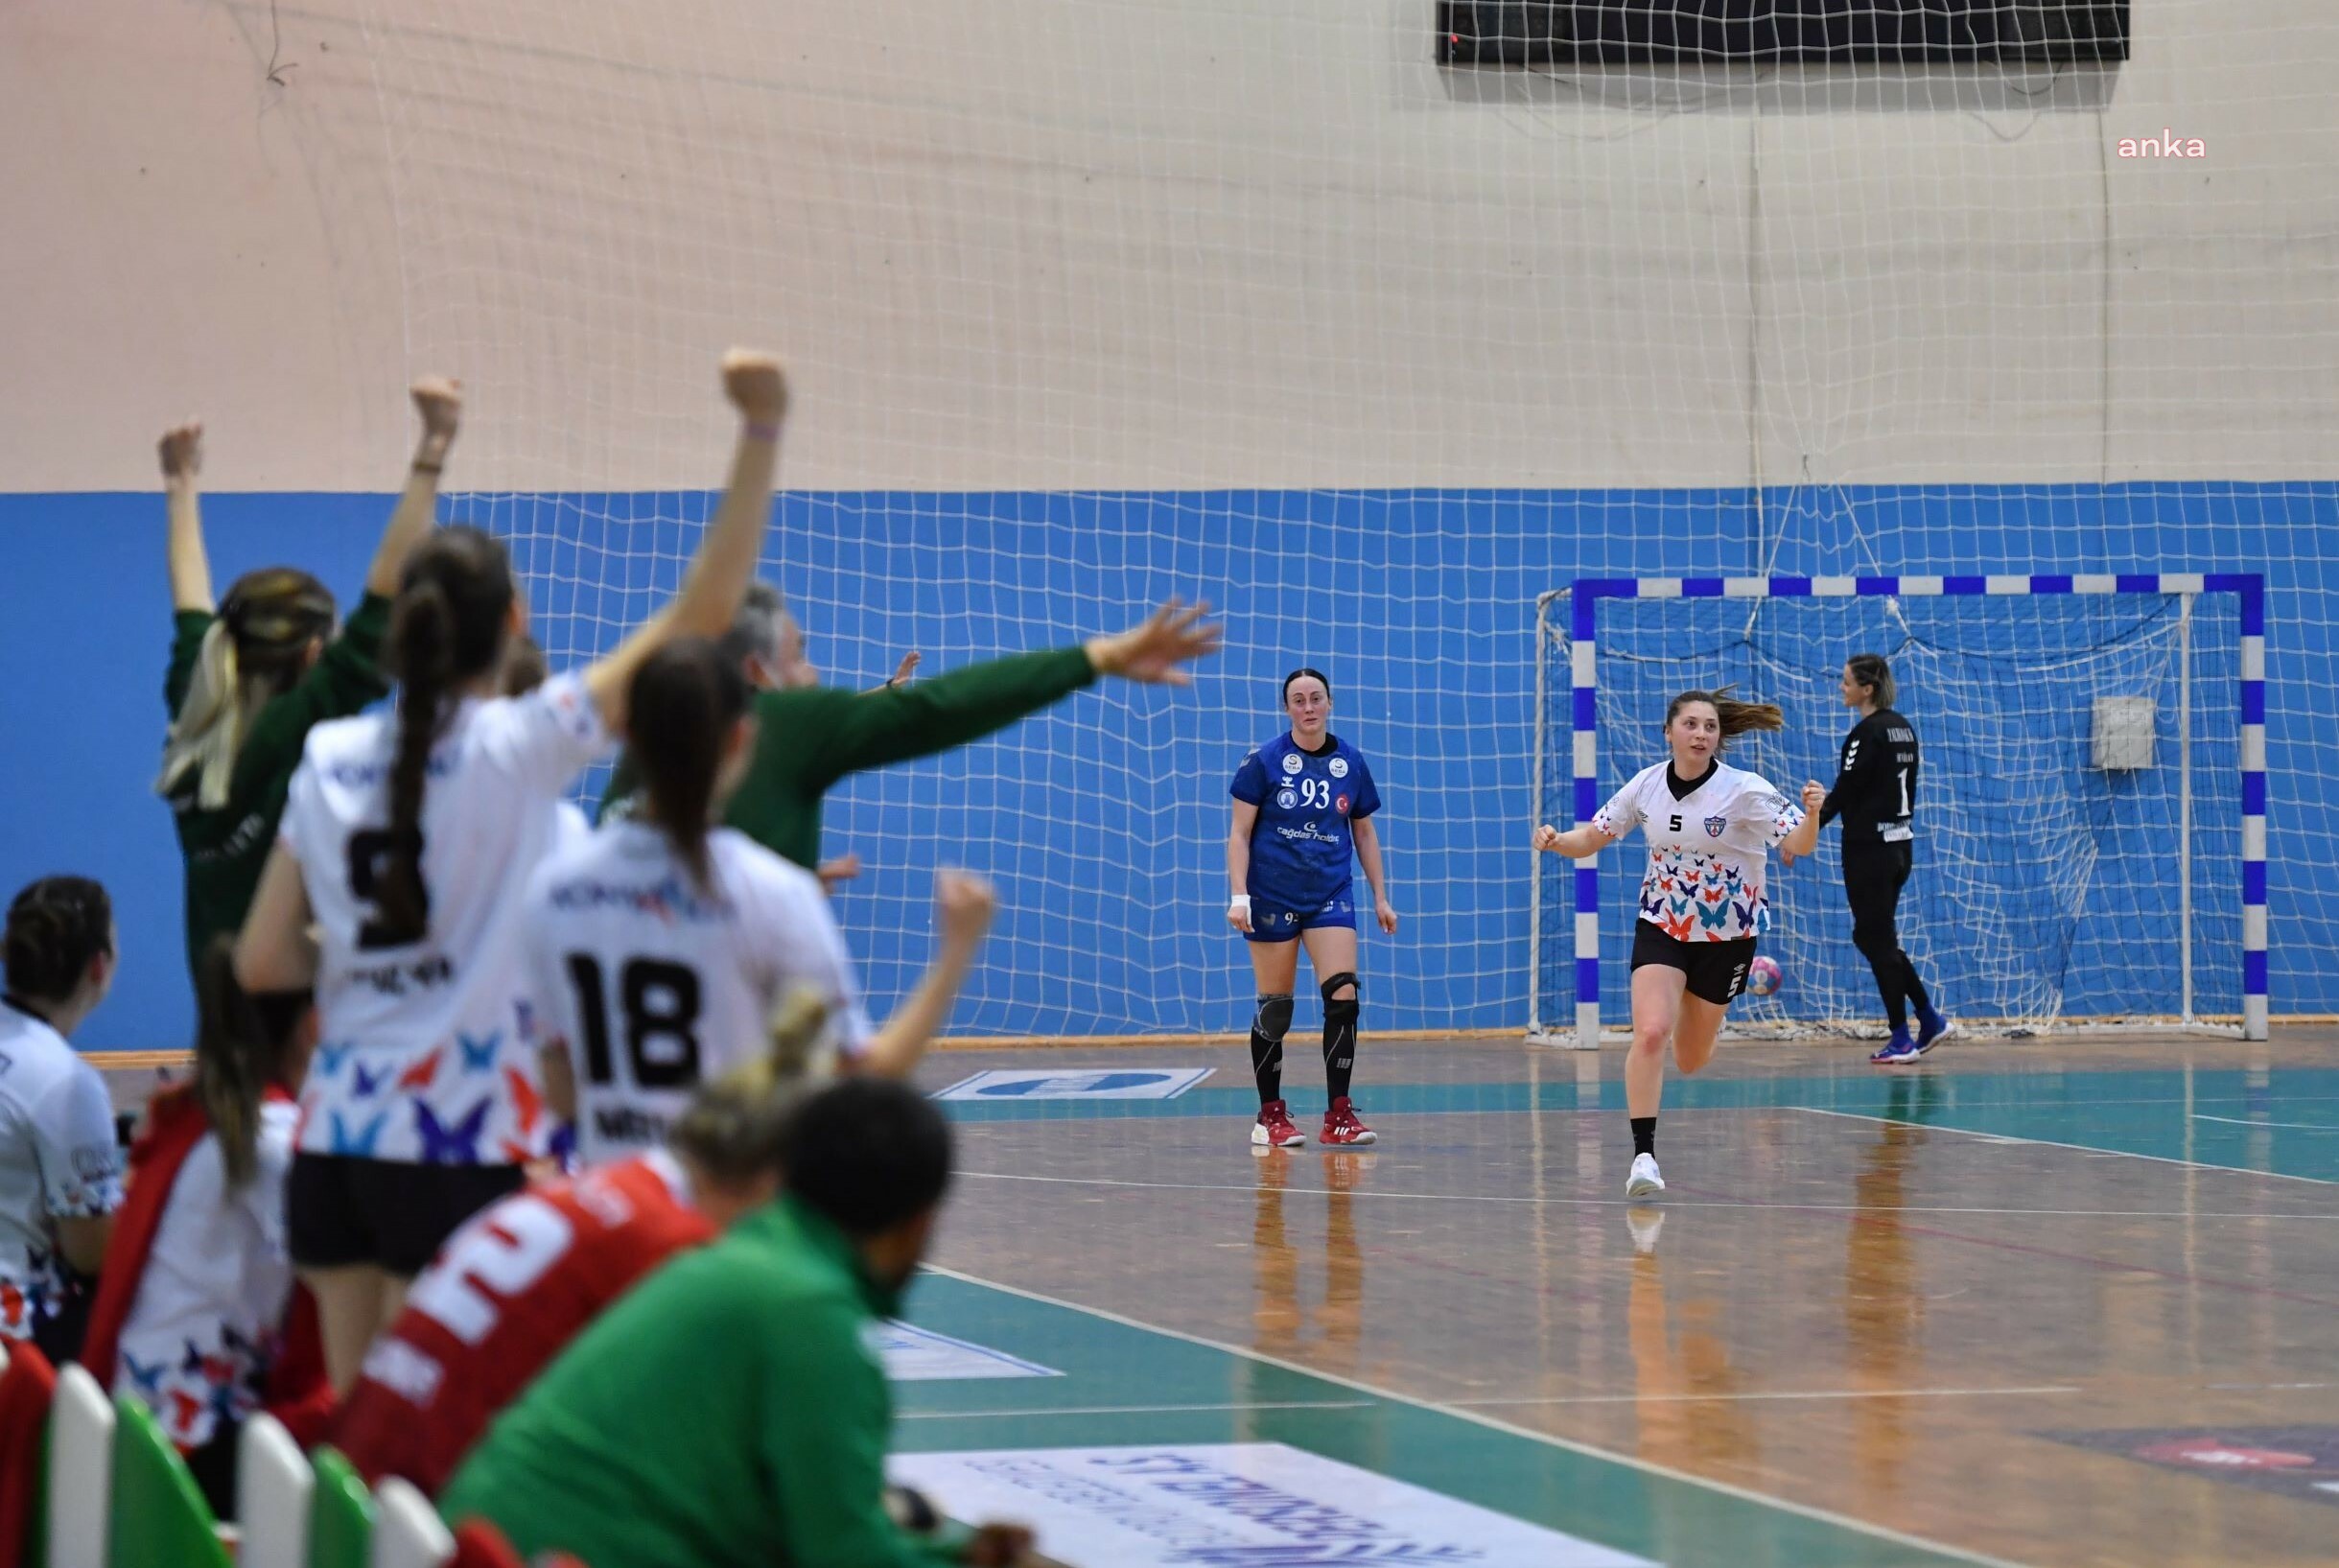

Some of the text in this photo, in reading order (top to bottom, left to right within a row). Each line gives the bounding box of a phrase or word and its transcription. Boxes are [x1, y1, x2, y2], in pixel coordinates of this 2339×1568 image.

[1299, 778, 1330, 809] 93
[1896, 767, 1911, 816] 1
[1669, 814, 1683, 832] 5
[564, 949, 700, 1089] 18
